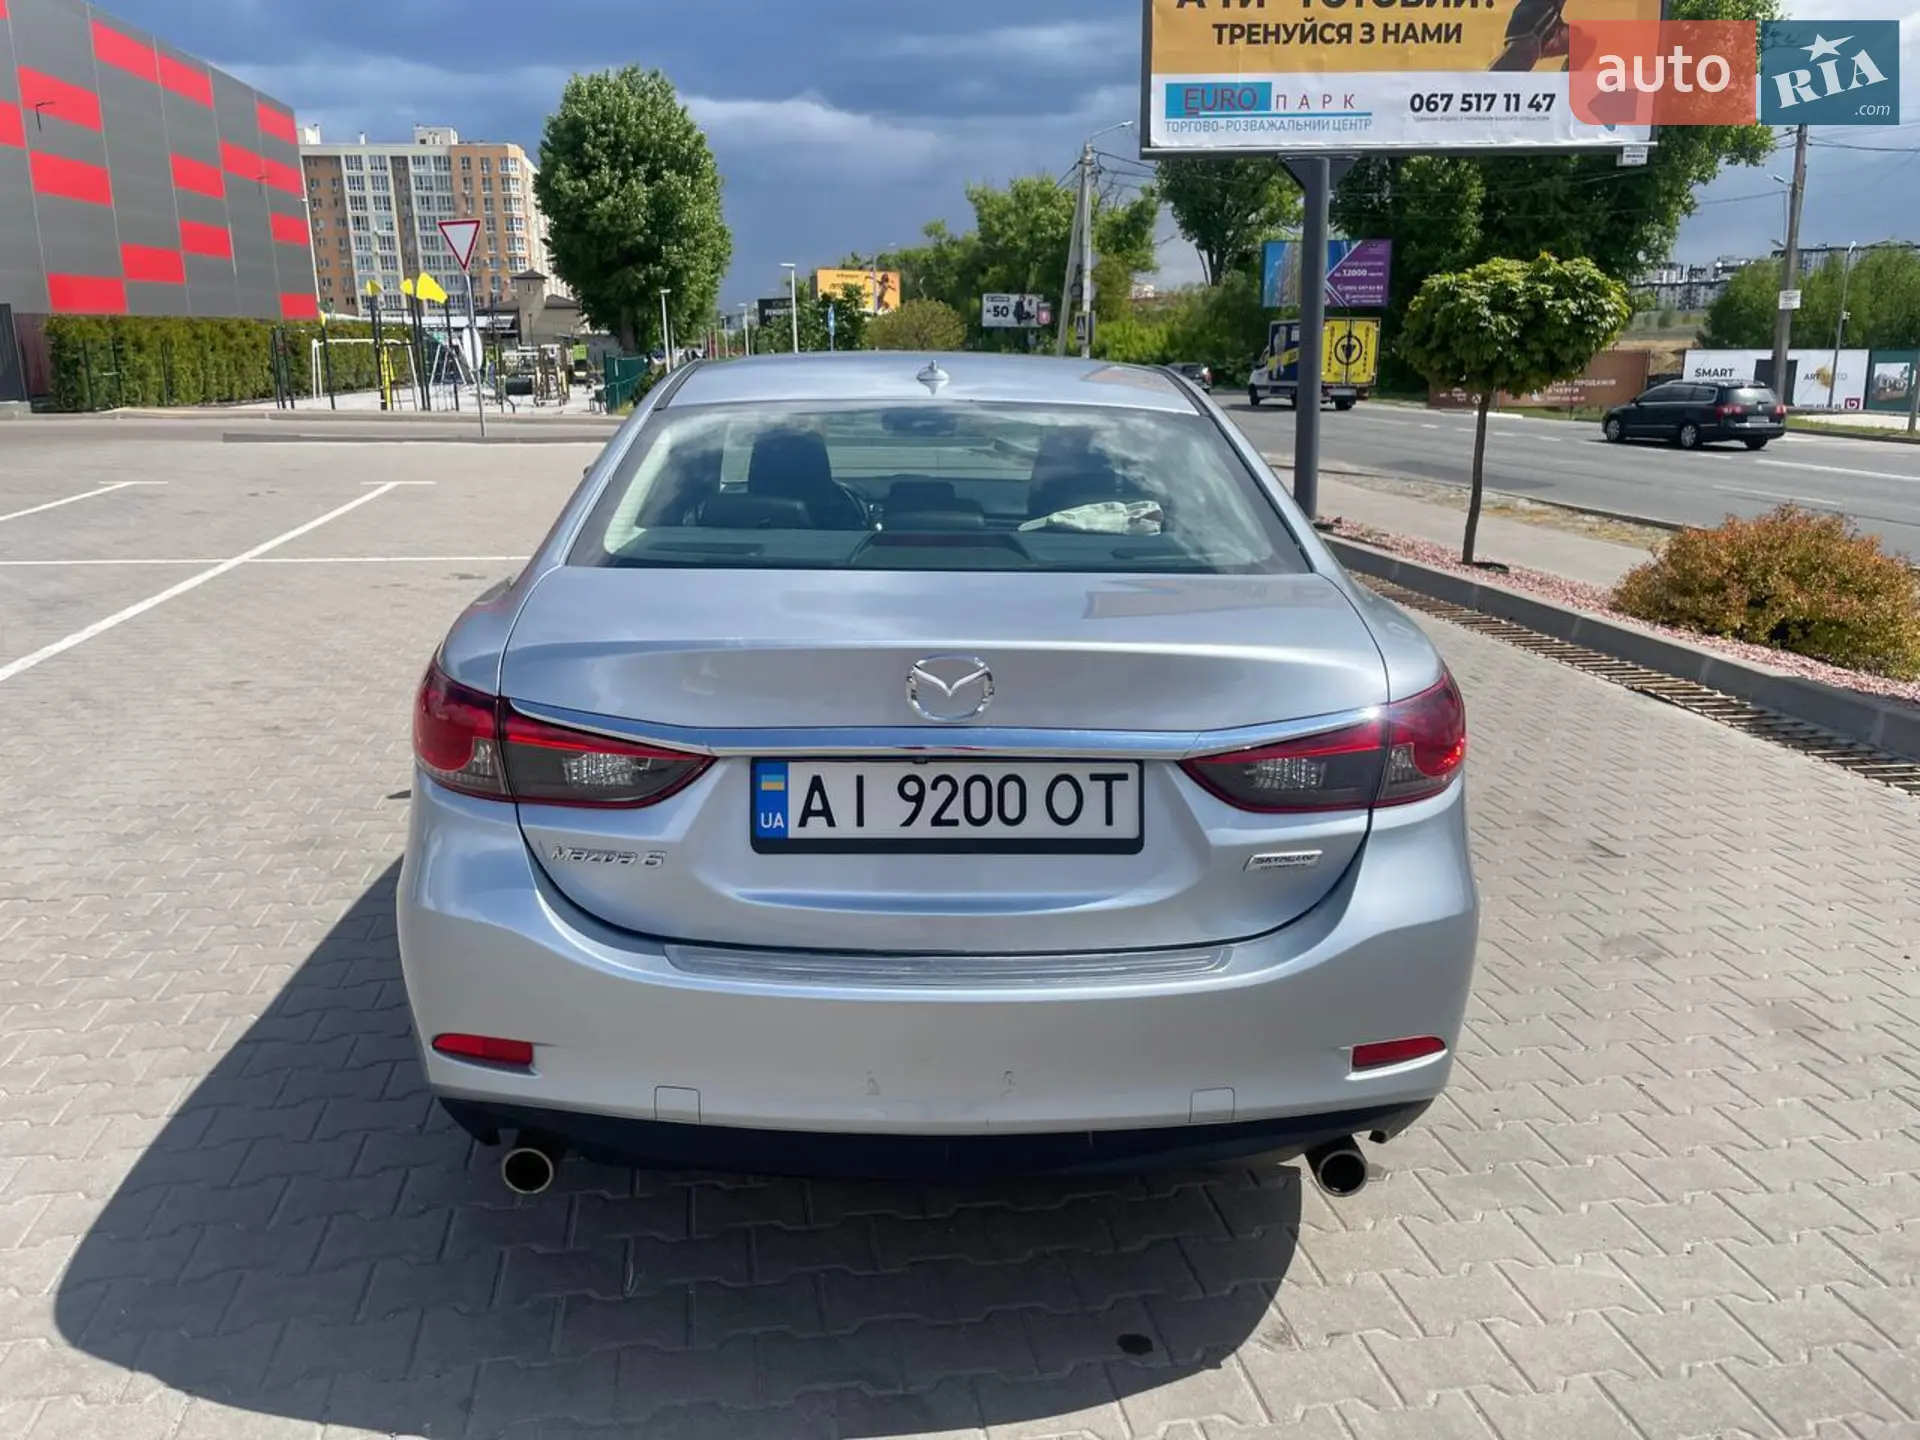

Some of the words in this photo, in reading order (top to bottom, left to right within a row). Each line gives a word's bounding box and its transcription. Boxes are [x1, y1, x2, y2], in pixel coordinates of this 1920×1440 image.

[1211, 17, 1353, 45] ТРЕНУЙСЯ
[1359, 22, 1375, 45] З
[1382, 22, 1463, 45] НАМИ
[1183, 87, 1258, 114] EURO
[1275, 93, 1356, 110] ПАРК
[1409, 92, 1454, 113] 067
[1459, 92, 1498, 113] 517
[1503, 92, 1521, 113] 11
[1527, 92, 1557, 113] 47
[1332, 119, 1373, 131] ЦЕНТР
[1694, 367, 1736, 378] SMART
[797, 774, 865, 828] AI
[896, 774, 1027, 828] 9200
[1045, 773, 1129, 828] OT
[760, 812, 785, 829] UA
[641, 849, 667, 868] 6
